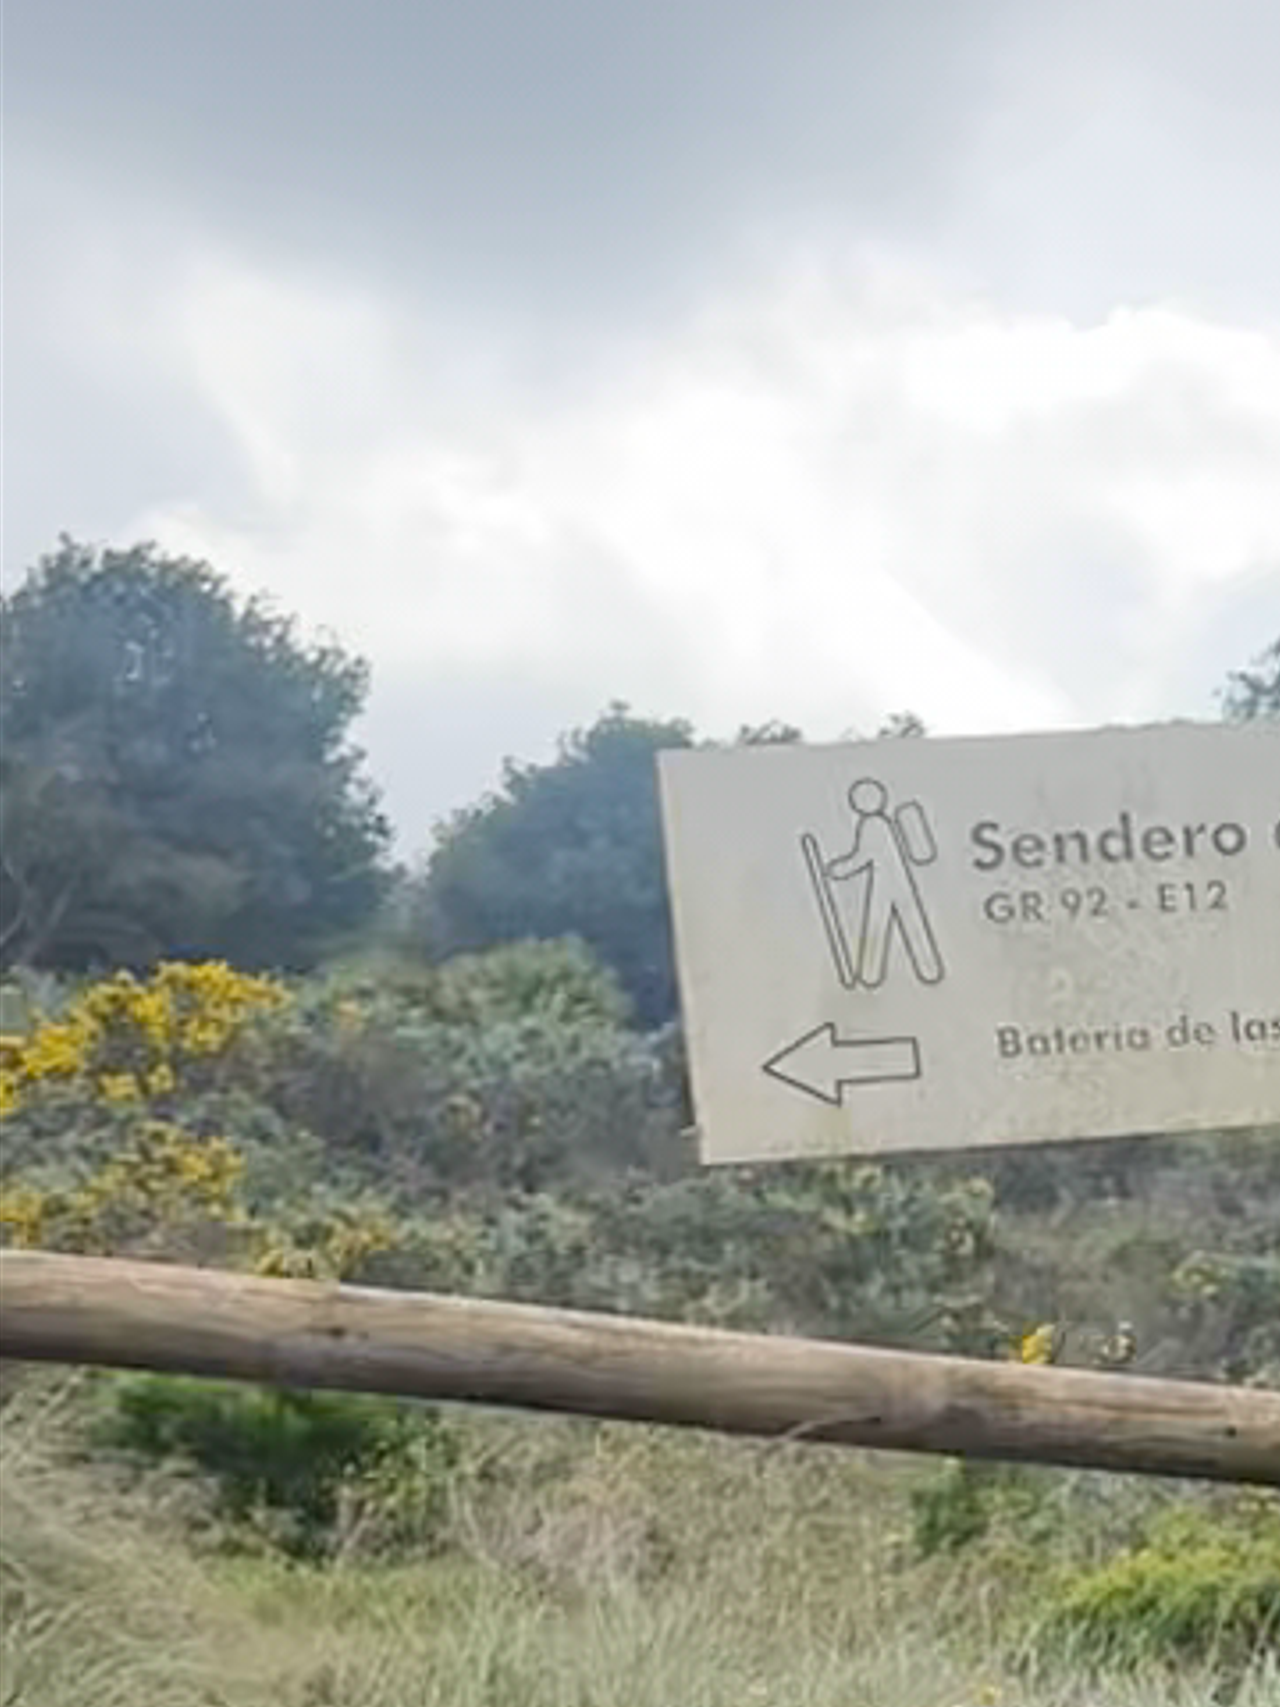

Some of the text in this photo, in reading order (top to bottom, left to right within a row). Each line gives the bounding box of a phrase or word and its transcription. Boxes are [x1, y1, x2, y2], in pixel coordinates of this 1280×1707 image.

[970, 811, 1248, 872] Sendero
[983, 891, 1044, 924] GR
[1061, 886, 1109, 917] 92
[1158, 879, 1230, 913] E12
[1167, 1014, 1217, 1048] de
